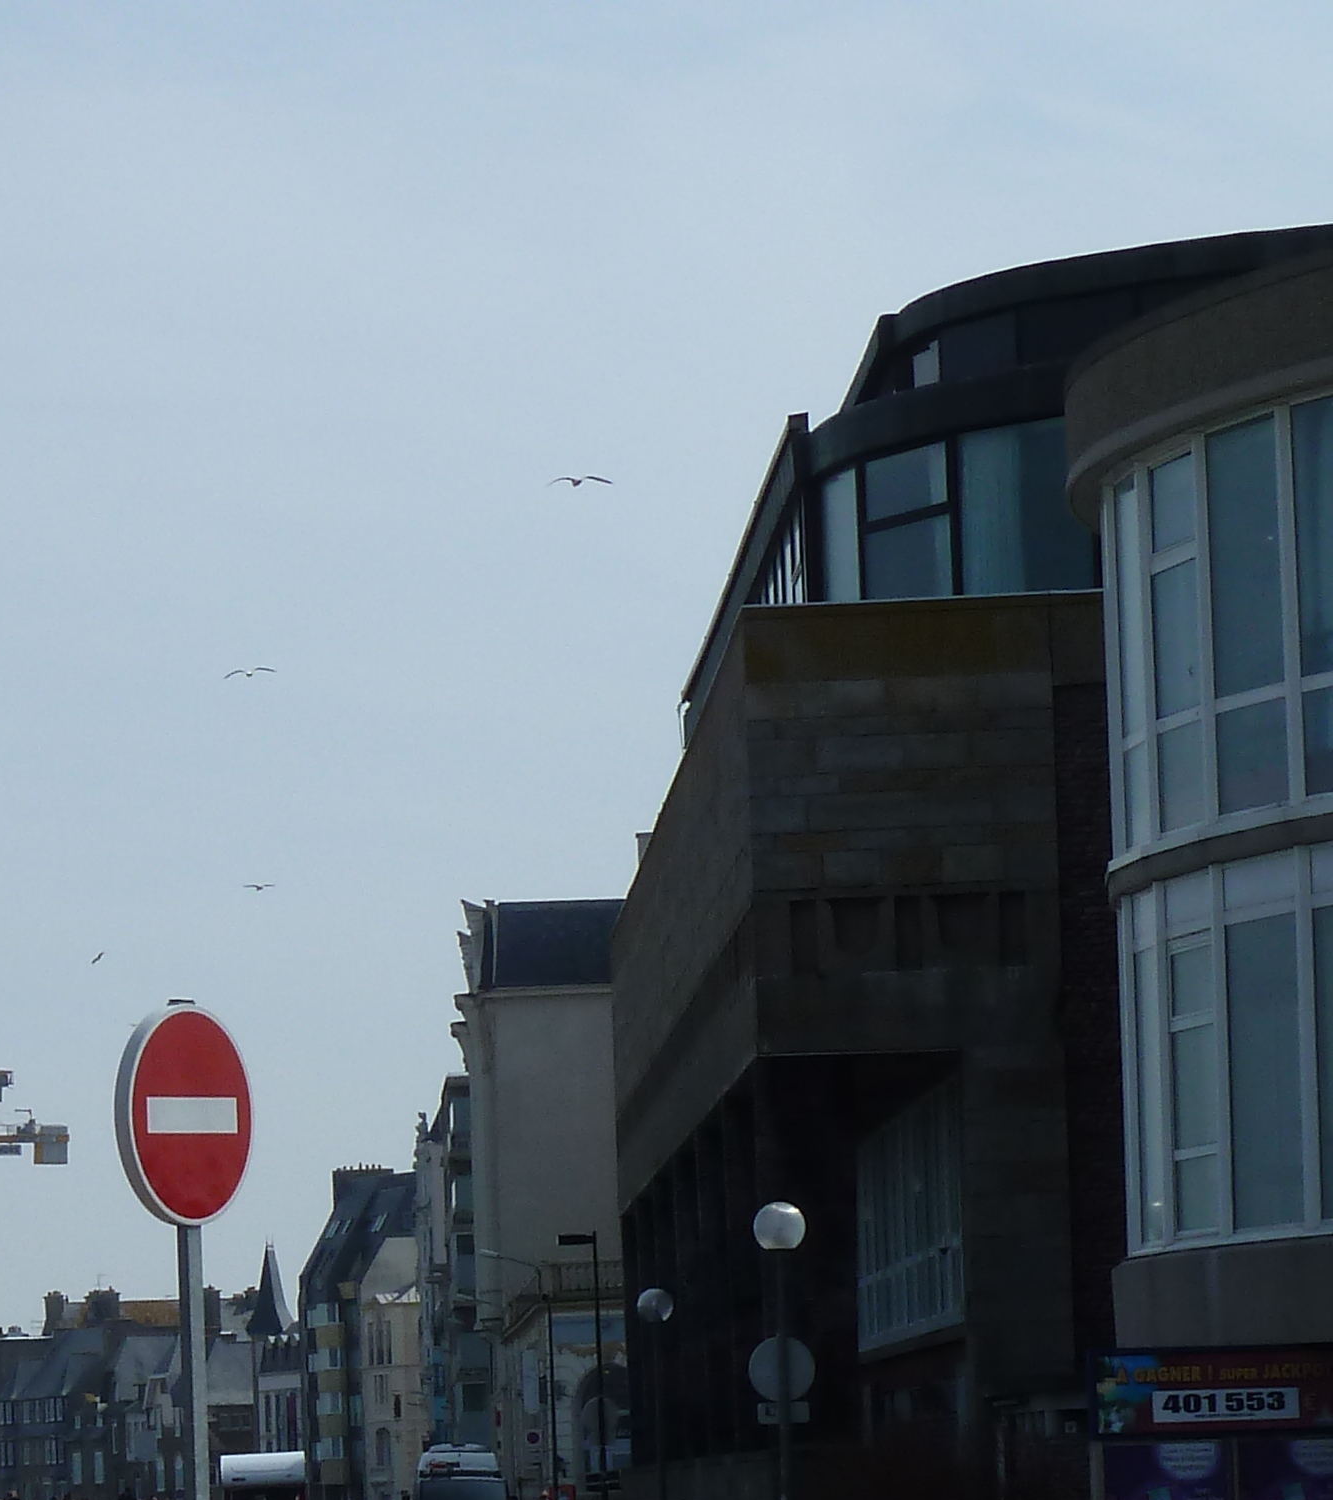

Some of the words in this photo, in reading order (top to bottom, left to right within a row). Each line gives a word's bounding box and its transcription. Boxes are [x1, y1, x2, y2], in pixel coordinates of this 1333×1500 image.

[1134, 1365, 1202, 1382] GAGNER
[1219, 1367, 1258, 1380] SUPER
[1162, 1394, 1217, 1413] 401
[1225, 1391, 1285, 1411] 553
